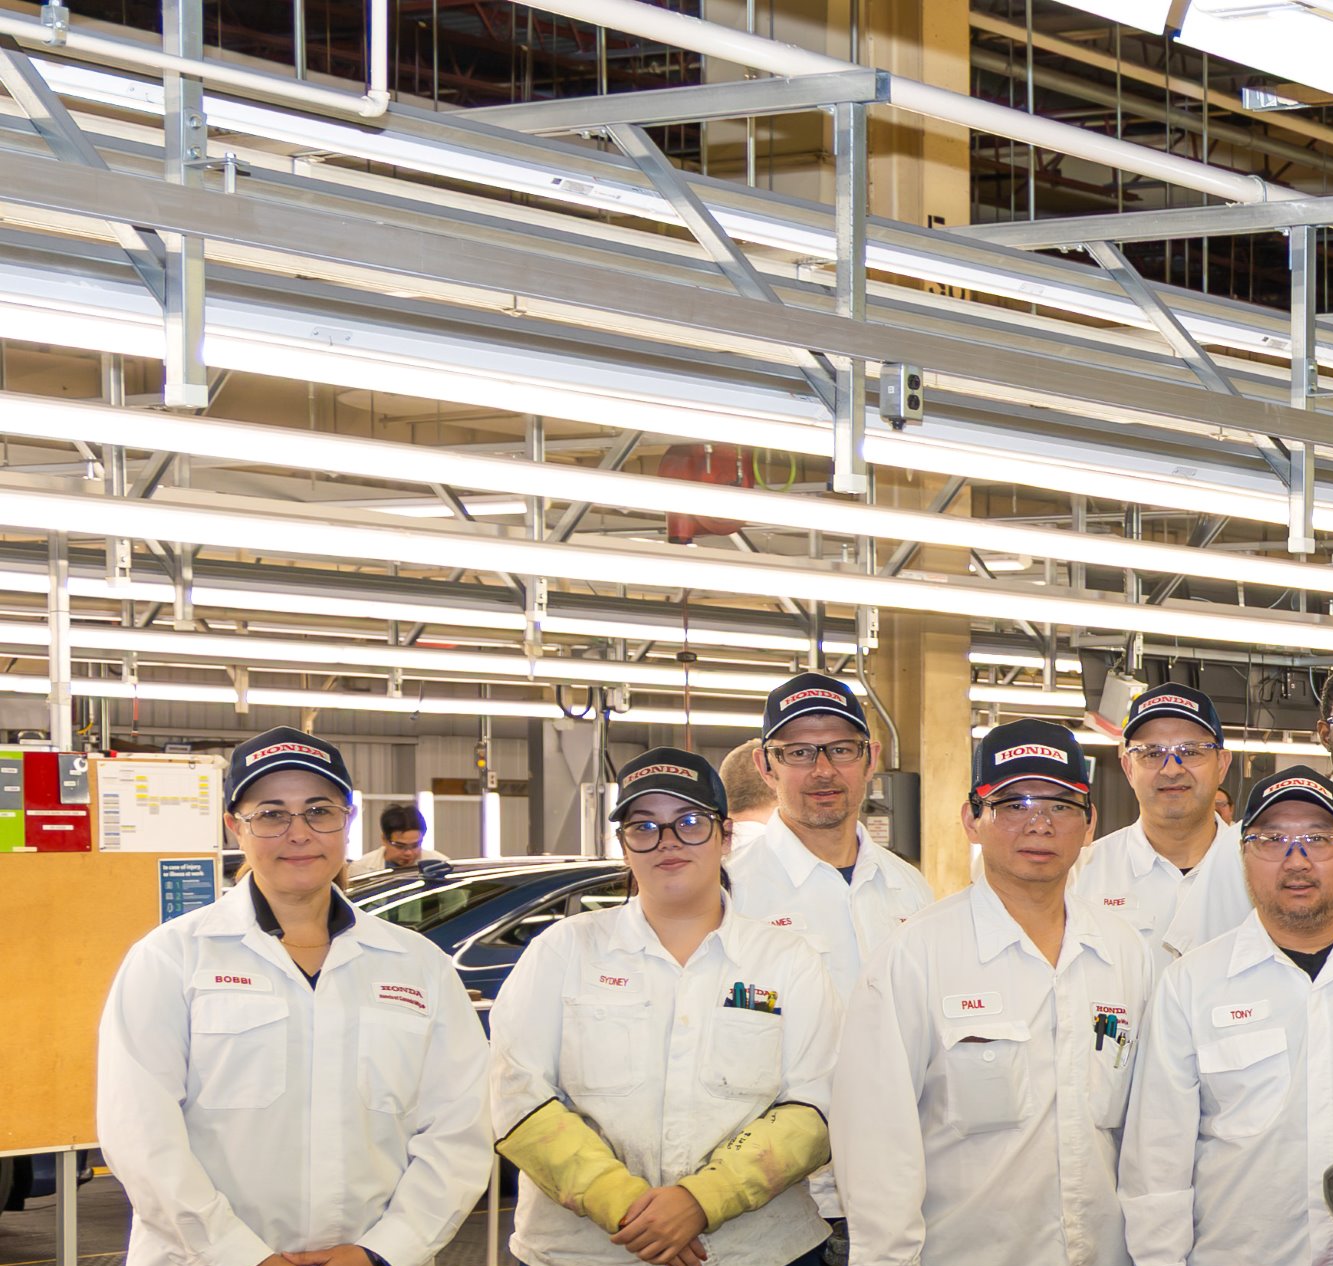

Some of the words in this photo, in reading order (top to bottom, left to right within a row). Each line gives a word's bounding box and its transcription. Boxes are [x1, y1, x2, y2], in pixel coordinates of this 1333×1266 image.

[785, 690, 843, 705] HONDA
[1141, 695, 1195, 709] HONDA
[252, 744, 326, 761] HONDA
[1000, 746, 1064, 761] HONDA
[628, 765, 693, 782] HONDA
[1268, 778, 1329, 795] HONDA
[768, 917, 792, 927] AMES
[214, 975, 252, 985] BOBBI
[599, 975, 629, 987] SYDNEY
[380, 985, 424, 999] HONDA
[961, 999, 985, 1010] PAUL
[1229, 1008, 1253, 1020] TONY
